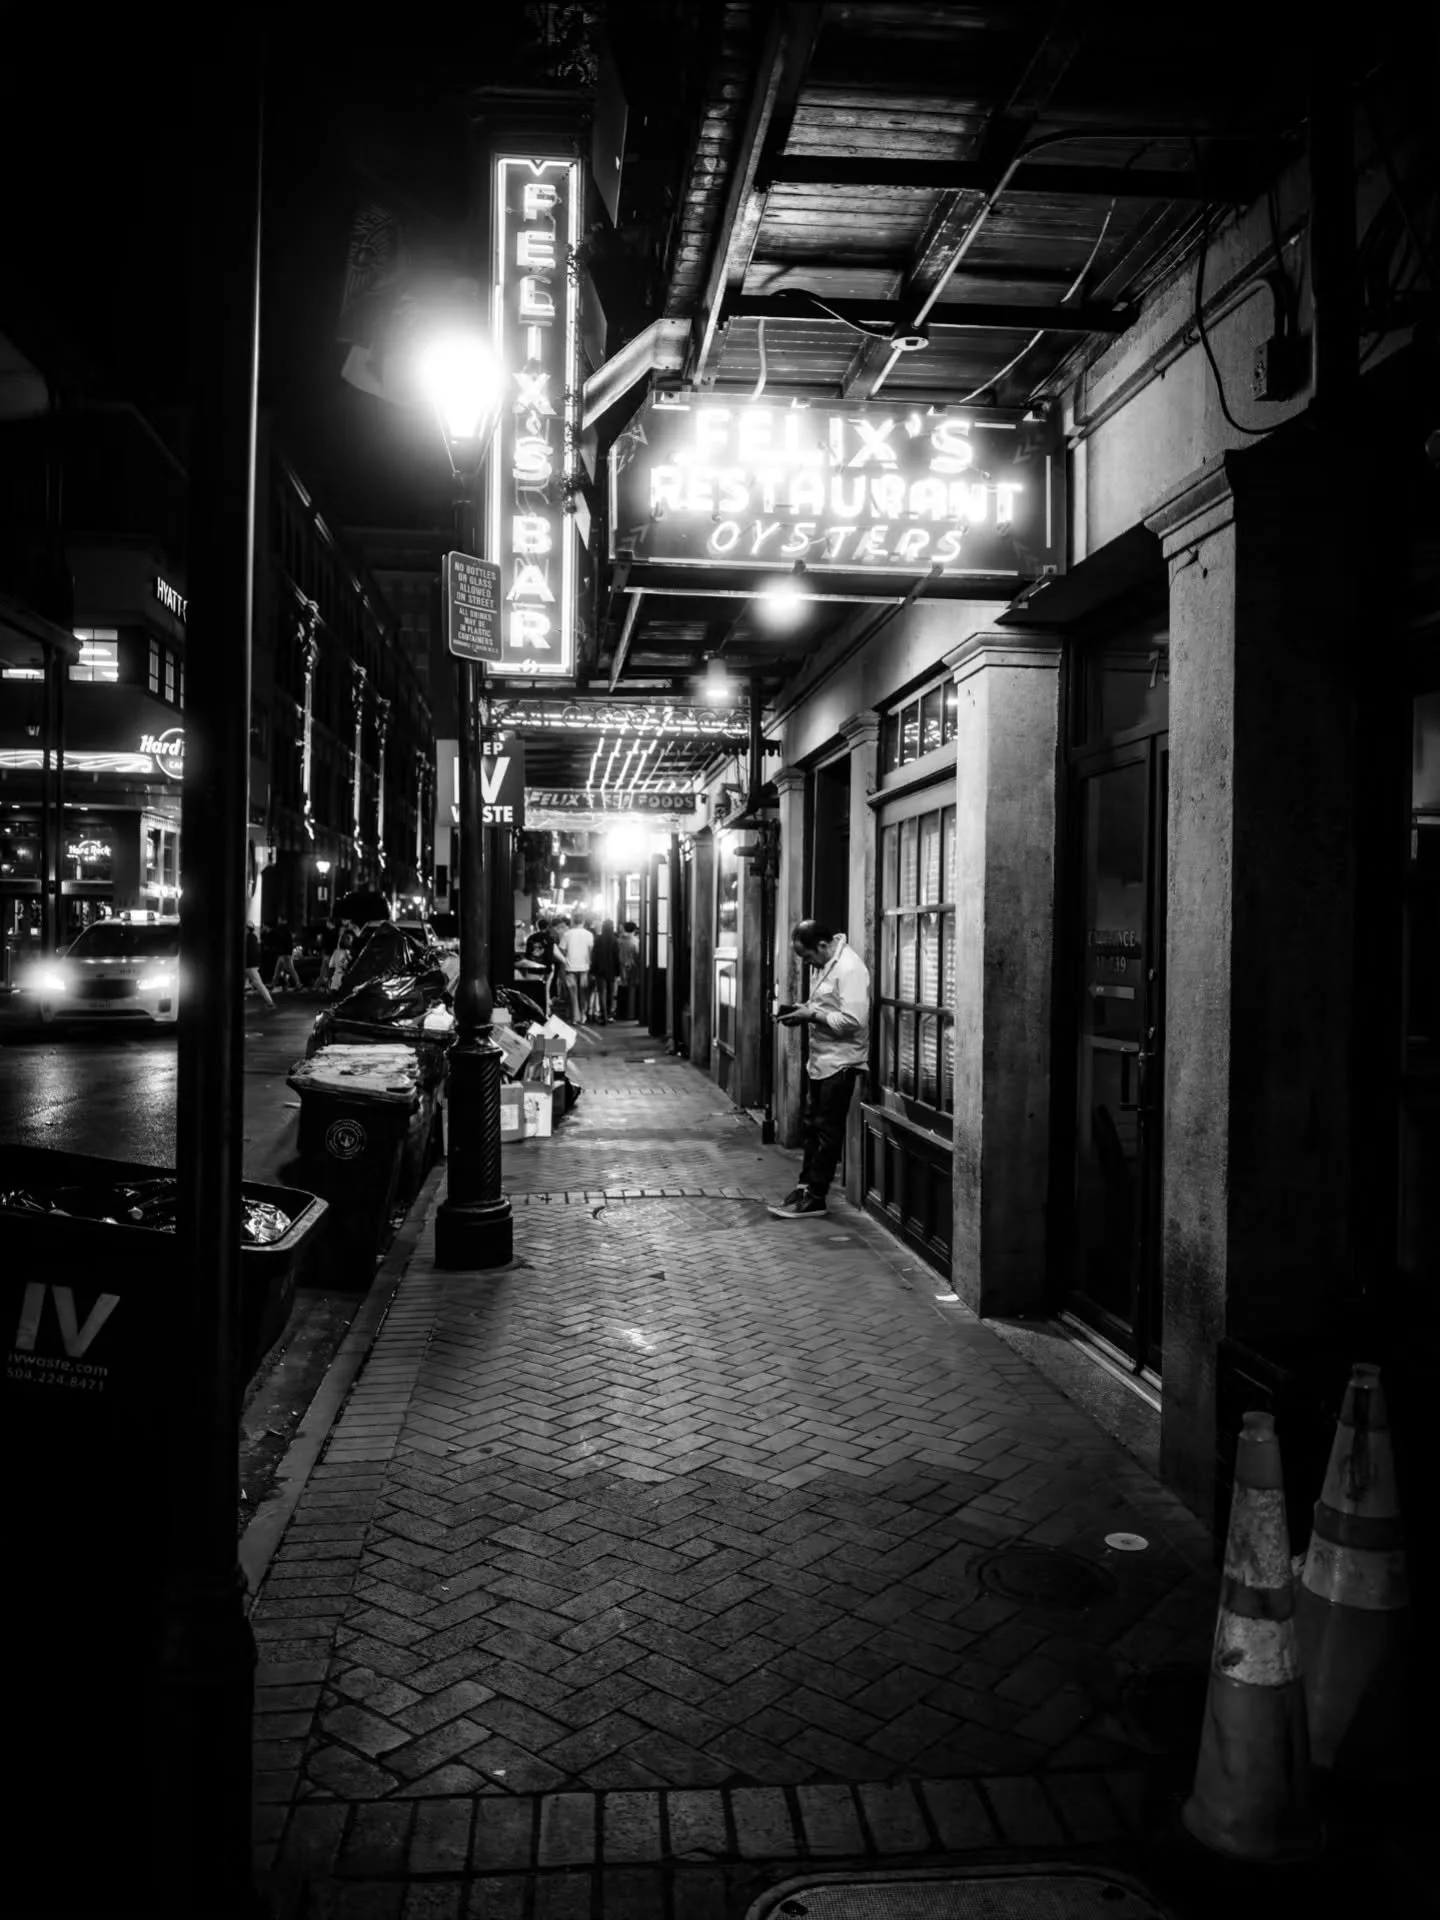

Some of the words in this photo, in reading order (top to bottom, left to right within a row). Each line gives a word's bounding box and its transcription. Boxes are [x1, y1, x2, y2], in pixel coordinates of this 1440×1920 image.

[511, 182, 558, 481] FELIX'S
[696, 408, 974, 473] FELIX'S
[650, 464, 1024, 523] RESTAURANT
[708, 519, 966, 563] OYSTERS
[454, 561, 465, 572] NO
[466, 565, 497, 580] BOTTLES
[458, 572, 467, 582] OR
[469, 575, 492, 589] GLASS
[506, 514, 557, 649] BAR
[157, 575, 183, 617] HYATT
[457, 592, 466, 602] ON
[468, 594, 494, 608] STREET
[460, 583, 491, 598] ALLOWED
[459, 607, 468, 617] ALL
[140, 734, 182, 756] Hard
[529, 791, 595, 807] FELIX'S
[638, 795, 694, 808] FOODS
[15, 1282, 120, 1358] IV
